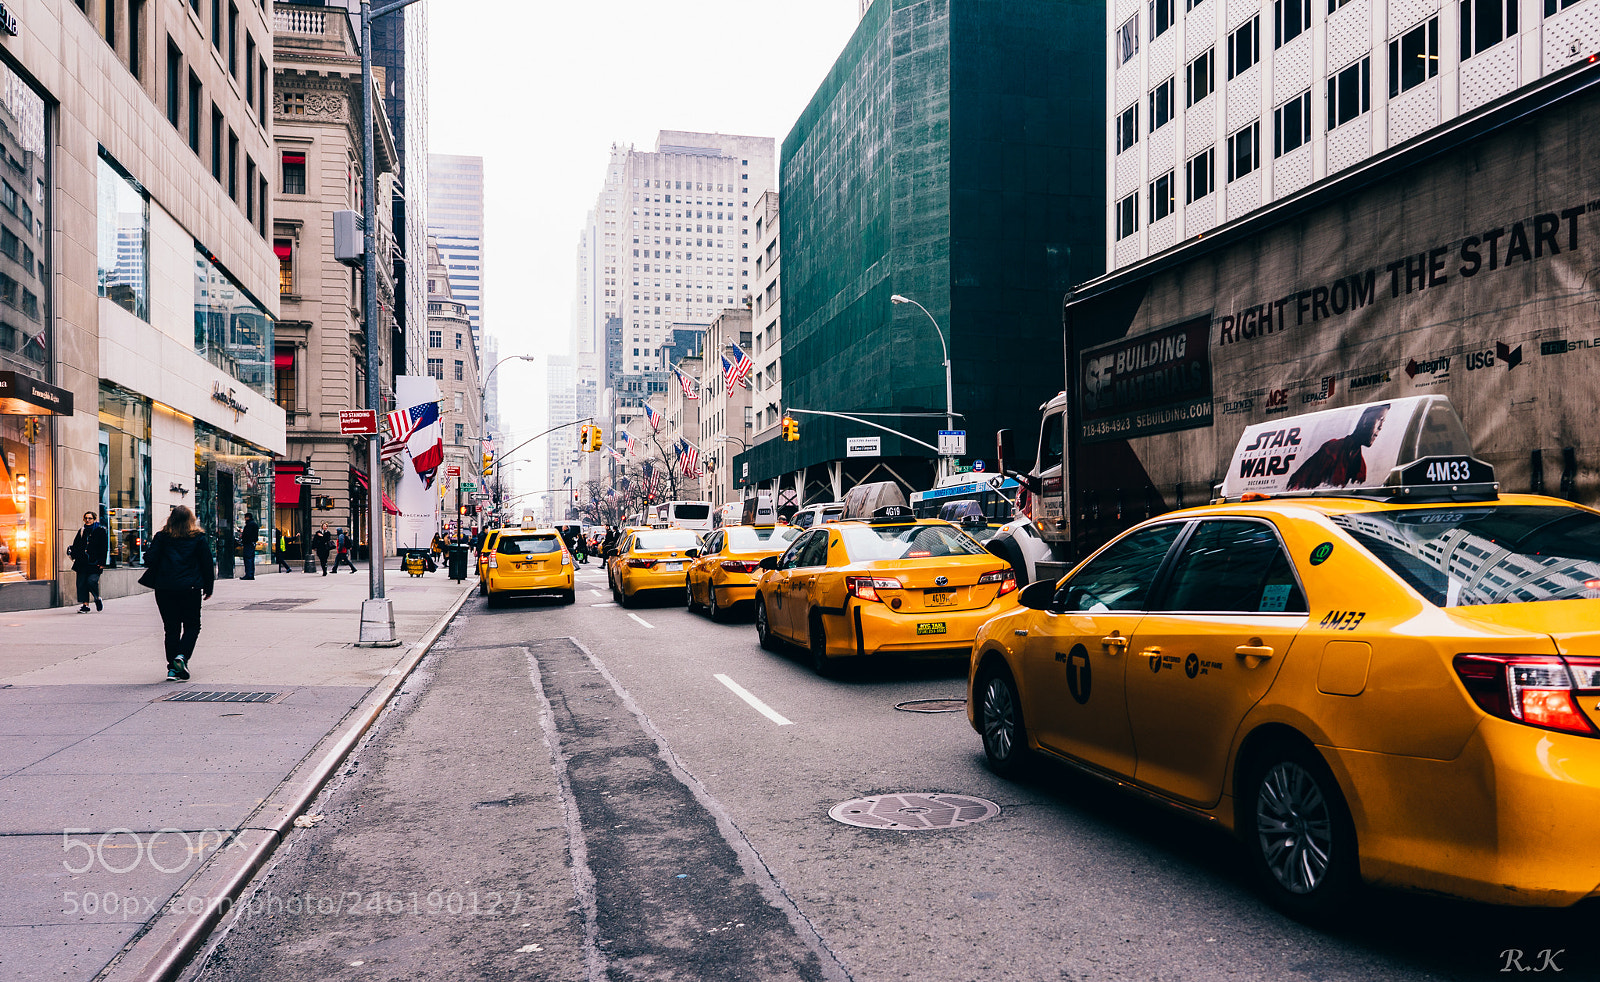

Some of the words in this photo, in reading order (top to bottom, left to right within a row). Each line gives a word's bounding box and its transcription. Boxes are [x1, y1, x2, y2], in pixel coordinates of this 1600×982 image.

[1219, 297, 1288, 346] RIGHT
[1297, 269, 1376, 326] FROM
[1386, 245, 1448, 298] THE
[1459, 204, 1586, 279] START
[1116, 333, 1187, 375] BUILDING
[1466, 350, 1495, 371] USG
[1413, 356, 1451, 375] Integrity
[1350, 374, 1381, 389] MARVIN
[1265, 389, 1289, 408] ACE
[1302, 391, 1328, 404] LEPAGE
[1083, 418, 1131, 437] 718-436-4923
[1136, 402, 1212, 428] SEBUILDING.COM
[1245, 427, 1302, 452] STAR
[1240, 453, 1296, 478] WARS
[1426, 460, 1471, 482] 4M33
[886, 507, 901, 516] 4G19
[1320, 610, 1366, 630] 4M33
[1055, 651, 1067, 664] NYC
